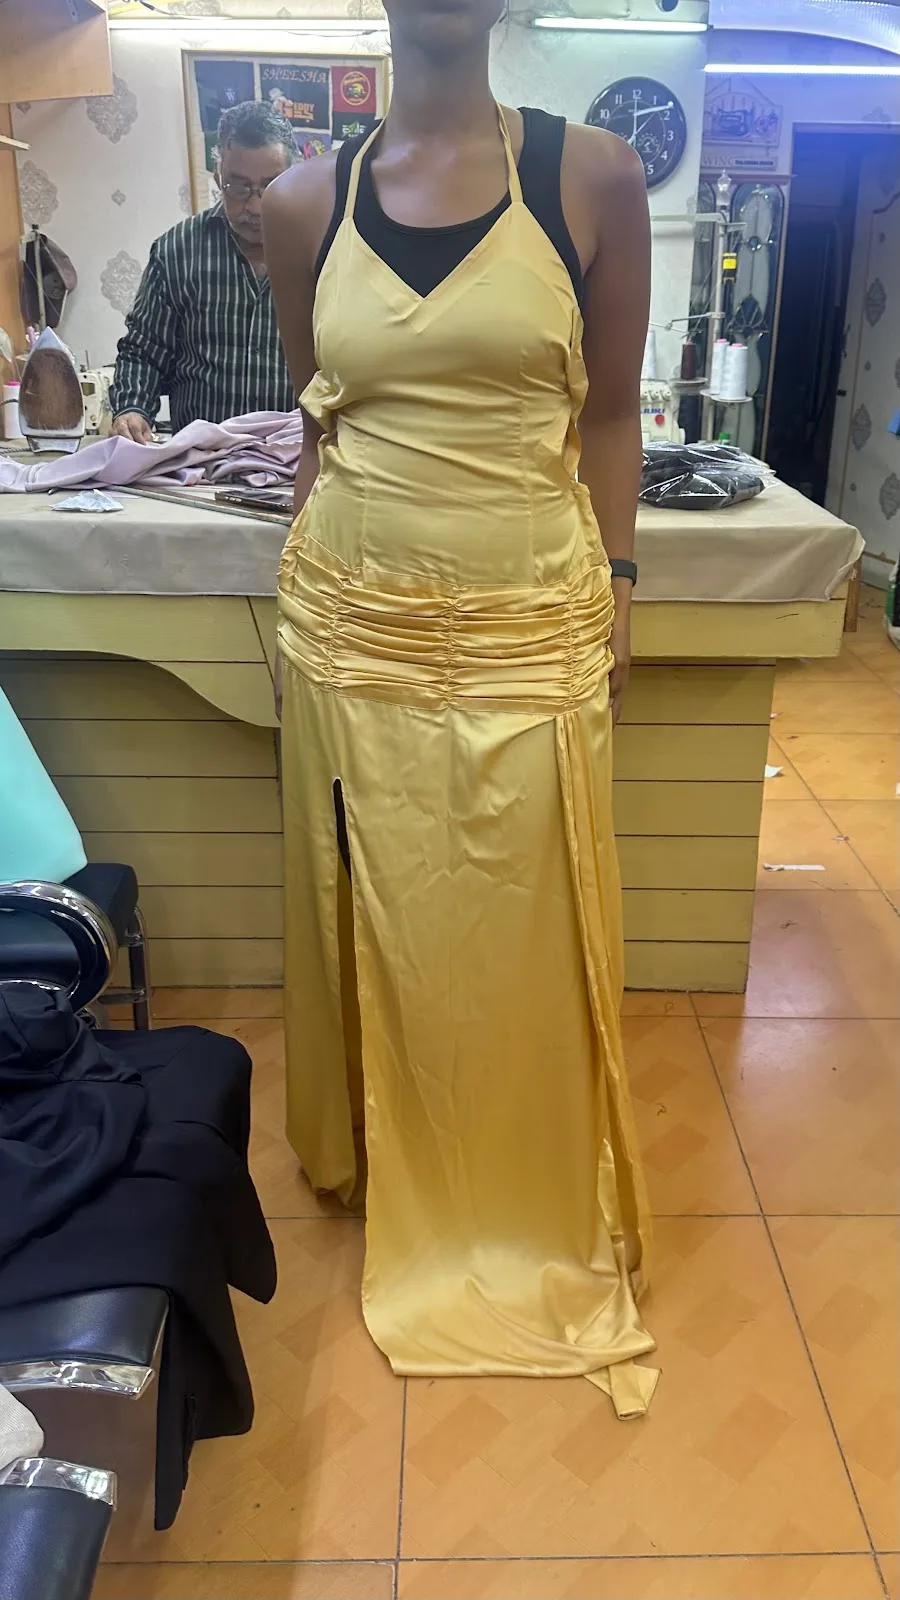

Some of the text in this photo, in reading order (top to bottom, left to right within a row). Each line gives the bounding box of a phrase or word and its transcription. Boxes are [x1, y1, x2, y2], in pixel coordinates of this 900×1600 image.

[262, 68, 327, 83] SHEESHA
[615, 94, 623, 105] 11
[633, 89, 642, 100] 12
[653, 95, 657, 106] 1
[600, 108, 610, 120] 10
[663, 110, 671, 121] 2
[666, 130, 674, 141] 3
[660, 150, 669, 161] 4
[646, 164, 655, 175] 5
